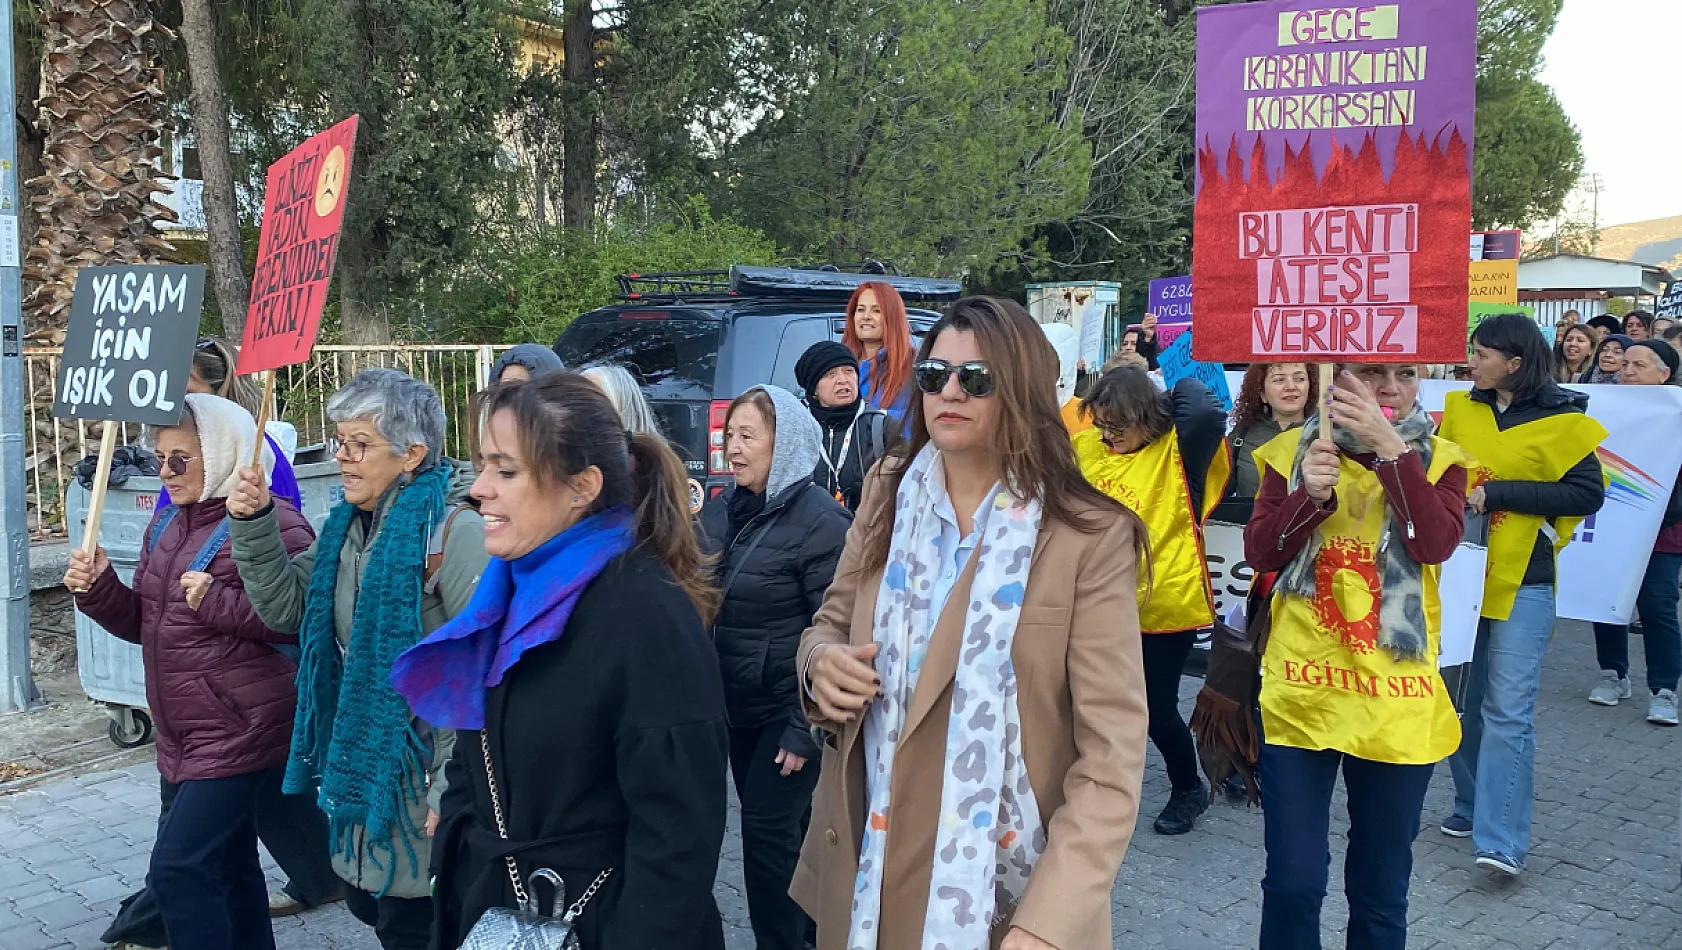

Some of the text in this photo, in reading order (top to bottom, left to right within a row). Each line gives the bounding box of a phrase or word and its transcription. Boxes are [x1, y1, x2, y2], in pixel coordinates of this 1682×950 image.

[1291, 7, 1376, 44] GECE
[1249, 47, 1422, 90] KARANLIKTAN
[1253, 90, 1412, 130] KORKARSAN
[1242, 205, 1415, 257] BU KENTİ
[1268, 256, 1390, 303] ATEŞE
[91, 316, 152, 367] İÇİN
[1253, 308, 1405, 352] VERİRİZ
[62, 366, 175, 415] IŞIK OL
[1284, 658, 1434, 698] EĞİTİM SEN
